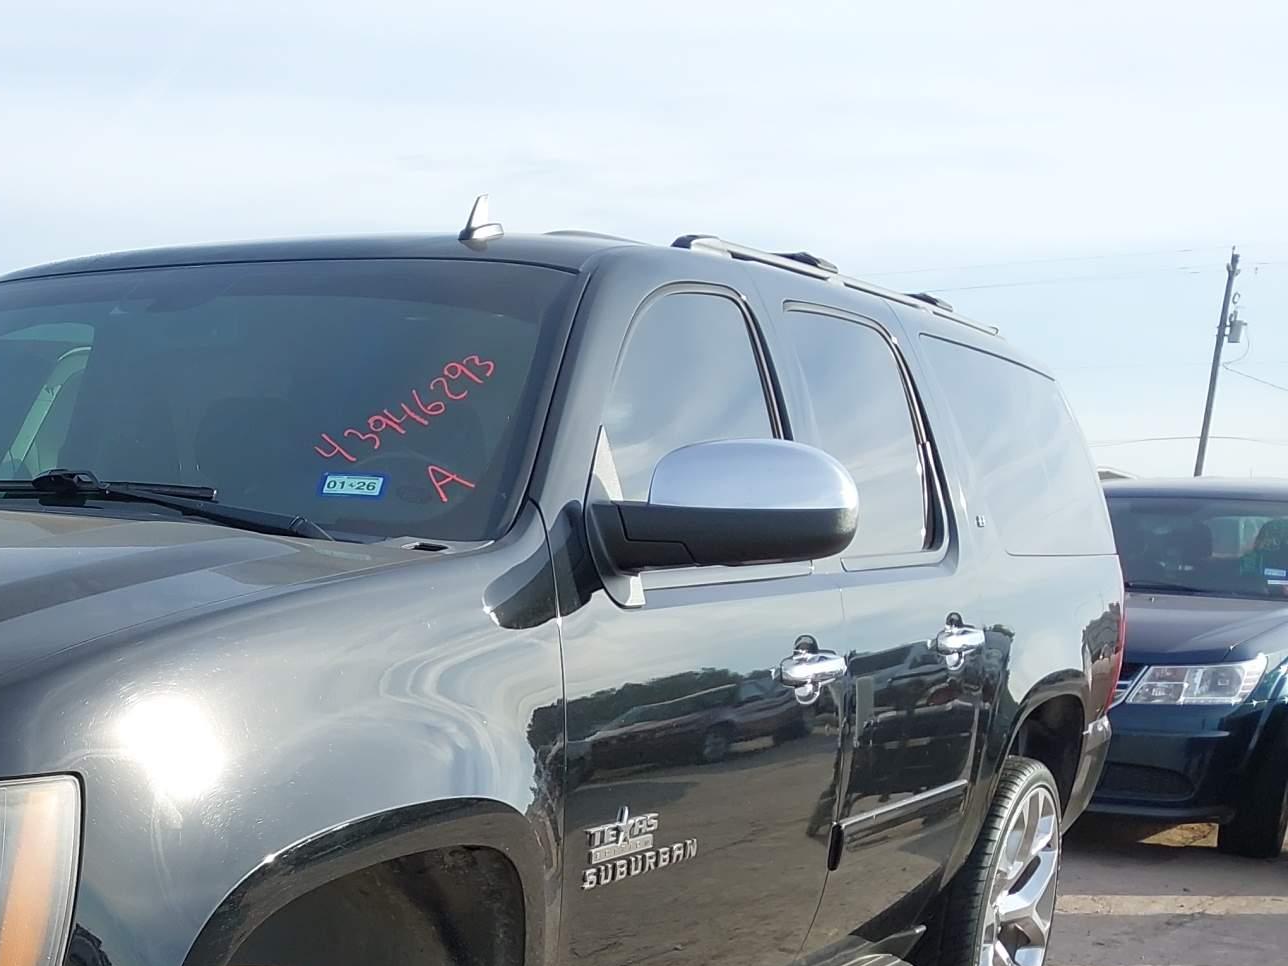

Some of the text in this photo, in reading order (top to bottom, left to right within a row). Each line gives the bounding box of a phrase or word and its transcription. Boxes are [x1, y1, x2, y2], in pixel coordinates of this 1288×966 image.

[313, 354, 496, 463] 43946293
[427, 463, 476, 502] A
[584, 805, 660, 848] TEXAS
[581, 838, 698, 891] SUBURBAN
